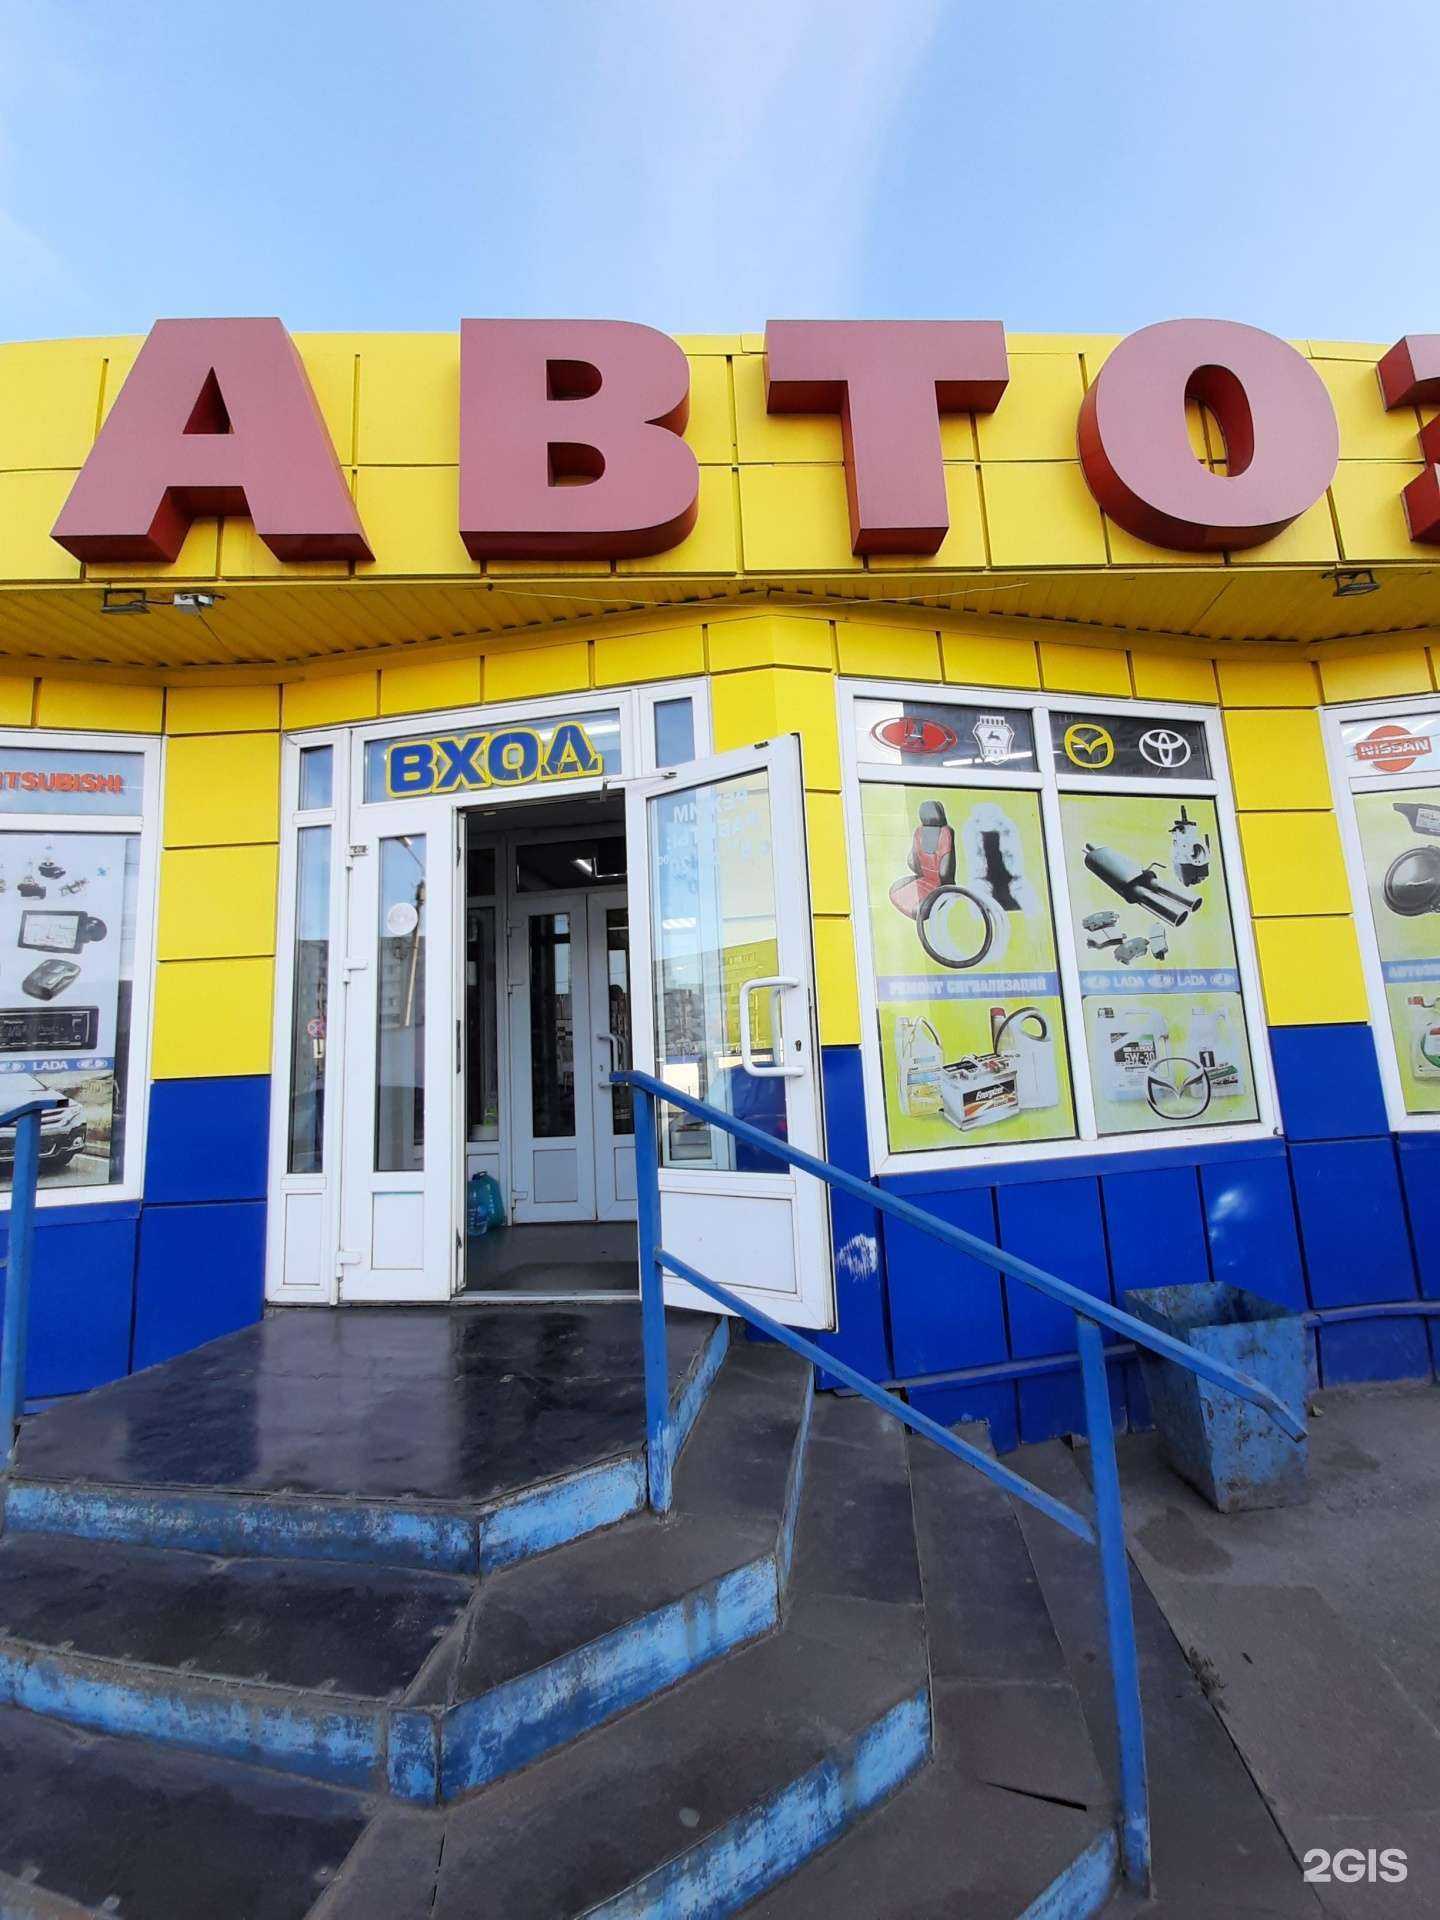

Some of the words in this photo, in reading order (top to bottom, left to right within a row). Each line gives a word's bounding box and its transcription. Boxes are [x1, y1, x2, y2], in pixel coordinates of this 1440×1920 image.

[1360, 739, 1430, 756] NISSAN
[387, 721, 602, 797] ВХОД
[1113, 975, 1145, 988] LADA
[1177, 972, 1207, 987] LADA
[32, 1059, 69, 1071] LADA
